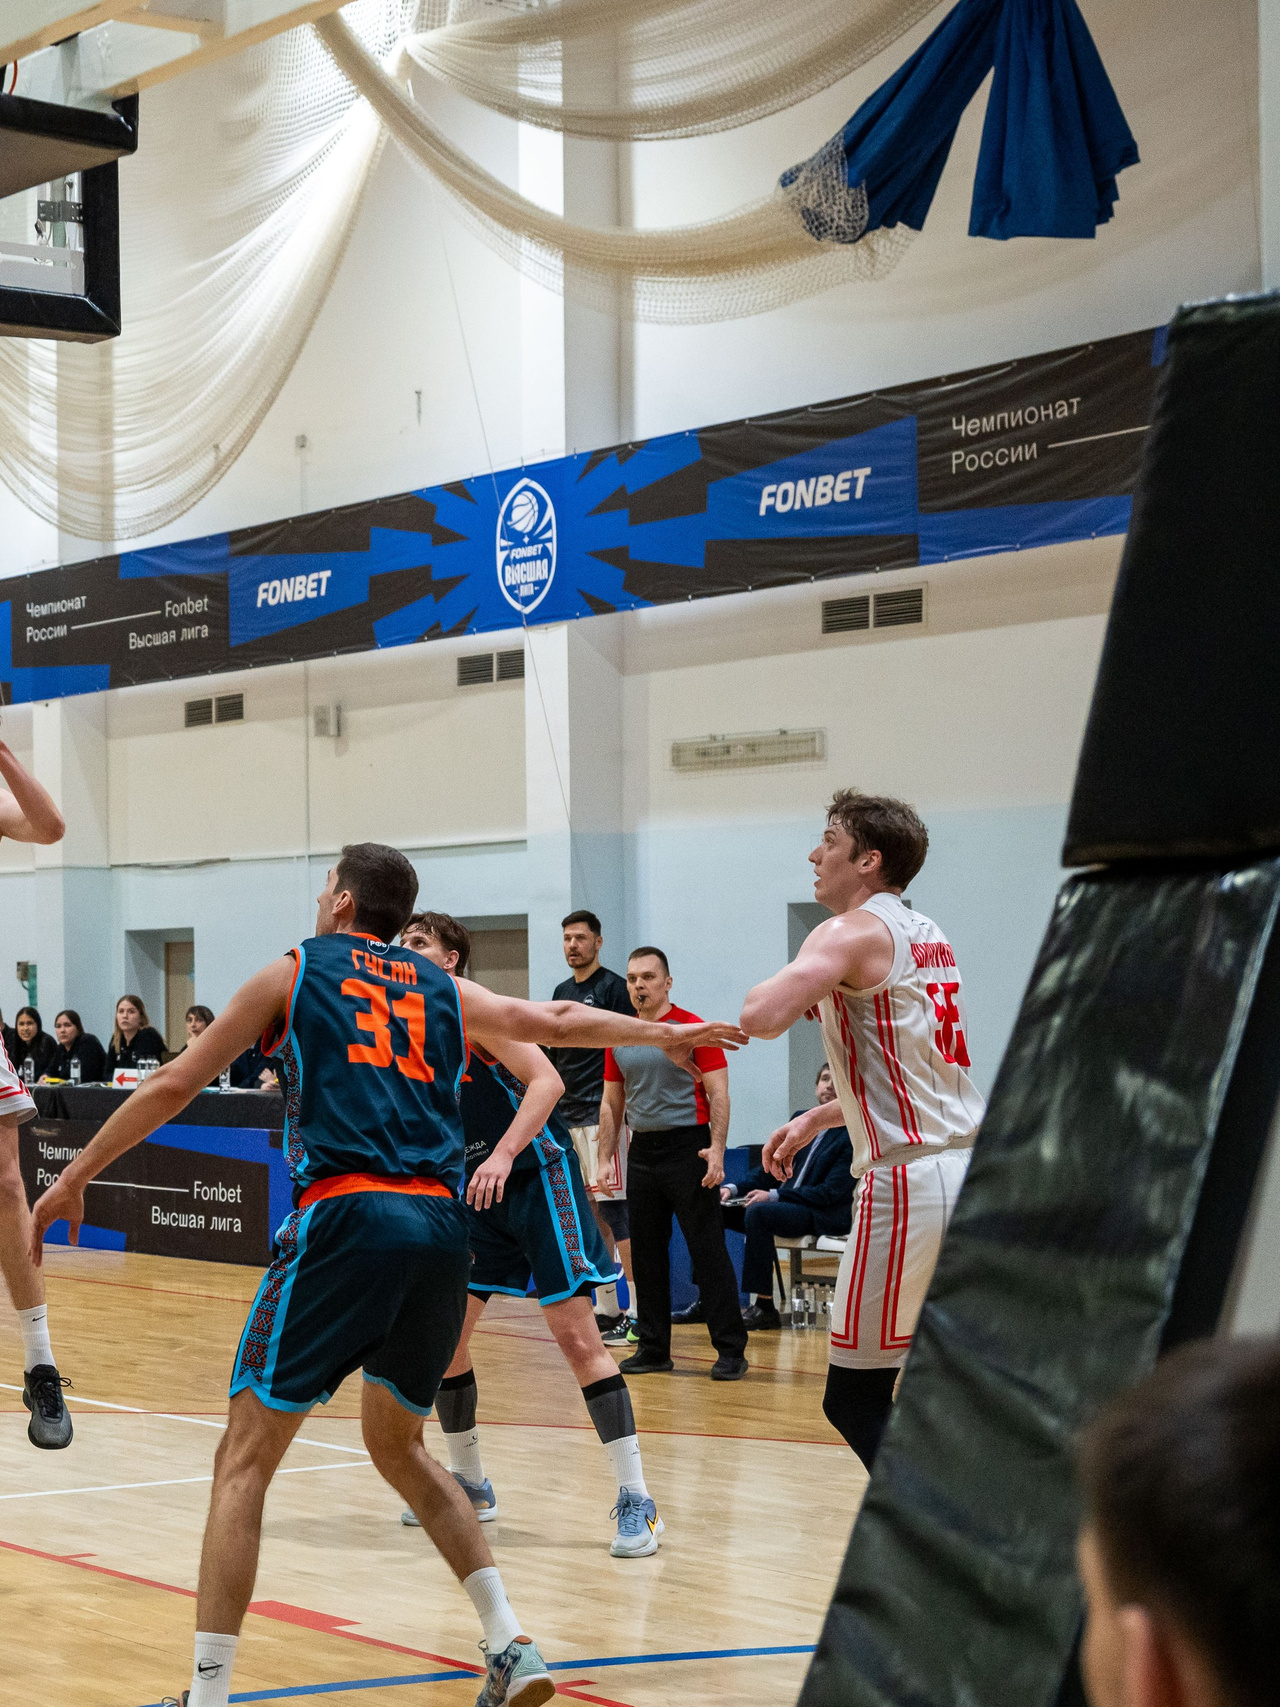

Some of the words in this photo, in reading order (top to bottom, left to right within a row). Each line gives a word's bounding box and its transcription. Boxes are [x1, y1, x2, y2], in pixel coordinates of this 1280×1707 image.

[951, 397, 1082, 438] Чемпионат
[951, 442, 1038, 474] России
[758, 466, 872, 517] FONBET
[510, 543, 544, 560] FONBET
[504, 558, 549, 587] ВЫСШАЯ
[256, 569, 332, 608] FONBET
[25, 595, 87, 618] Чемпионат
[26, 624, 68, 643] России
[164, 595, 209, 618] Fonbet
[128, 630, 177, 650] Высшая
[180, 624, 209, 642] лига
[351, 948, 418, 986] ГУСАК
[340, 977, 435, 1084] 31
[38, 1141, 84, 1161] Чемпи
[193, 1180, 242, 1204] Fonbet
[151, 1205, 205, 1230] Высшая
[210, 1215, 242, 1234] лига
